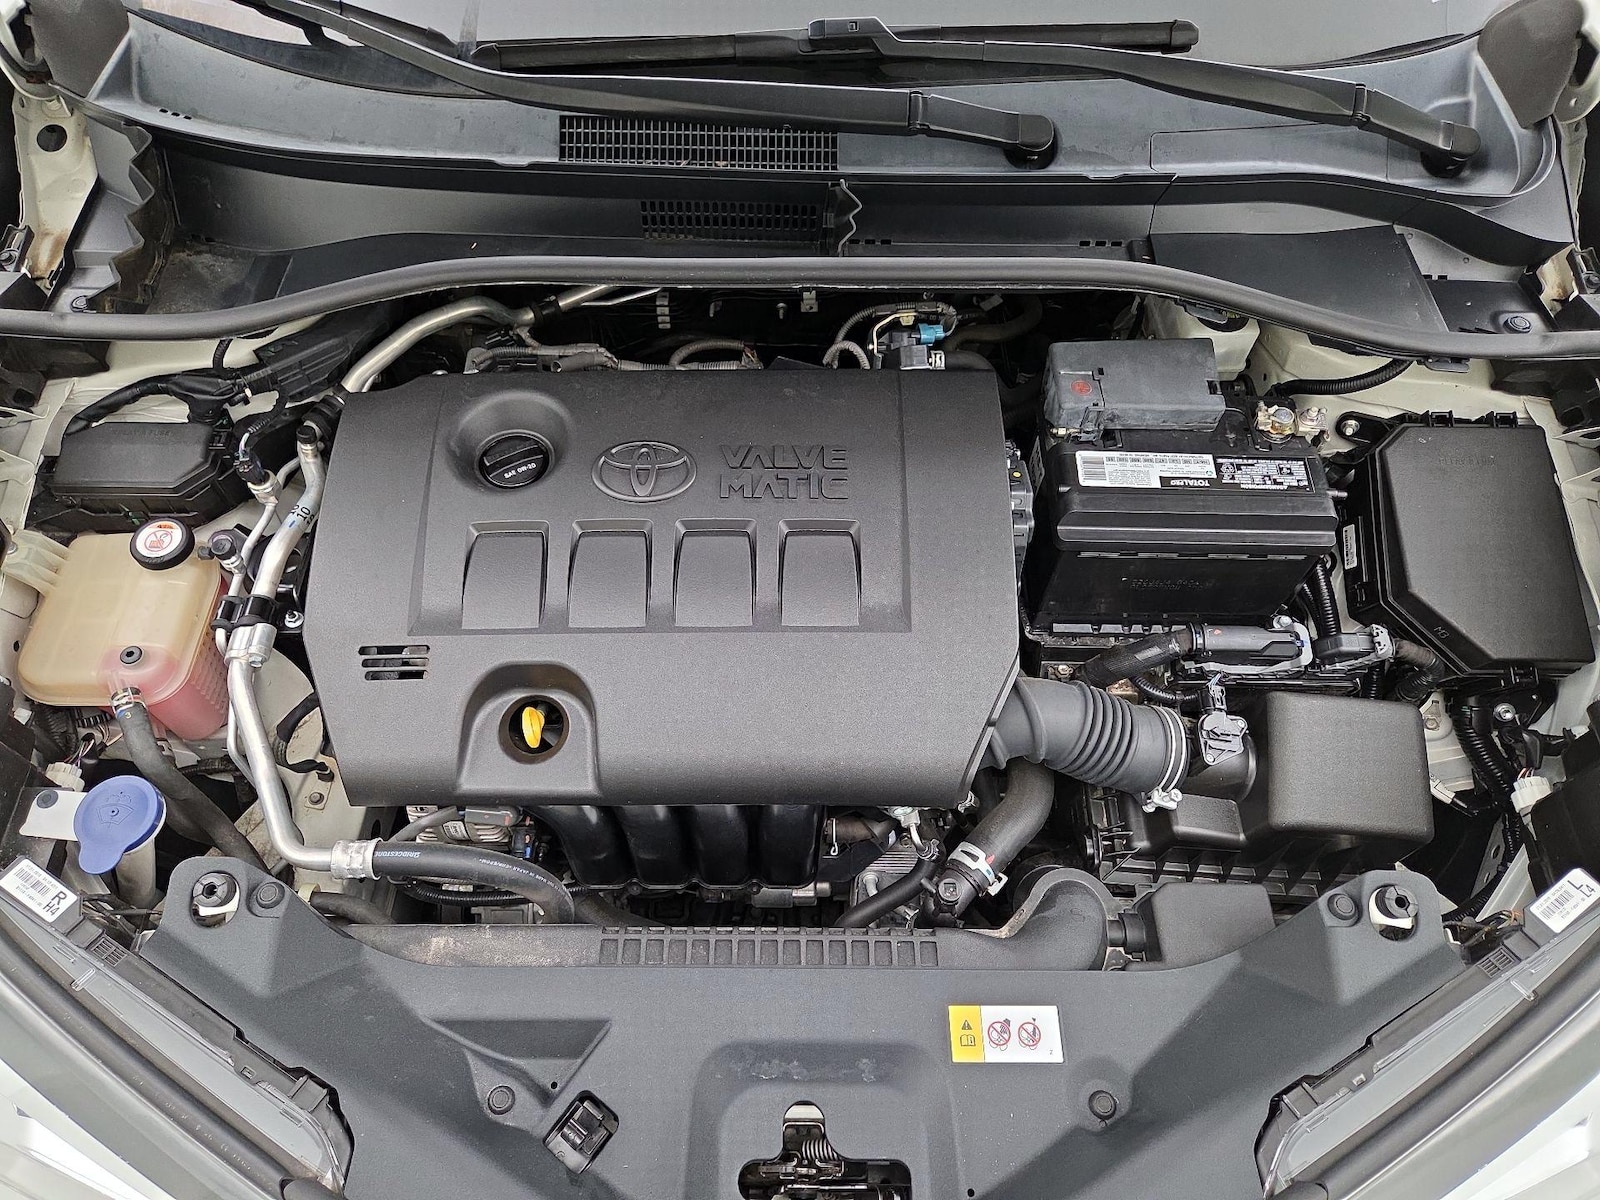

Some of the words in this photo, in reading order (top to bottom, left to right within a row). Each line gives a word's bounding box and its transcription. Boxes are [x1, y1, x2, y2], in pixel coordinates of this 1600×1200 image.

[720, 445, 847, 469] VALVE
[504, 470, 516, 479] SAE
[517, 463, 536, 473] 0W-20
[720, 474, 848, 499] MATIC
[297, 506, 310, 521] 10
[1567, 880, 1583, 890] L
[1579, 884, 1596, 898] L4
[51, 891, 67, 906] R
[43, 902, 60, 916] H4
